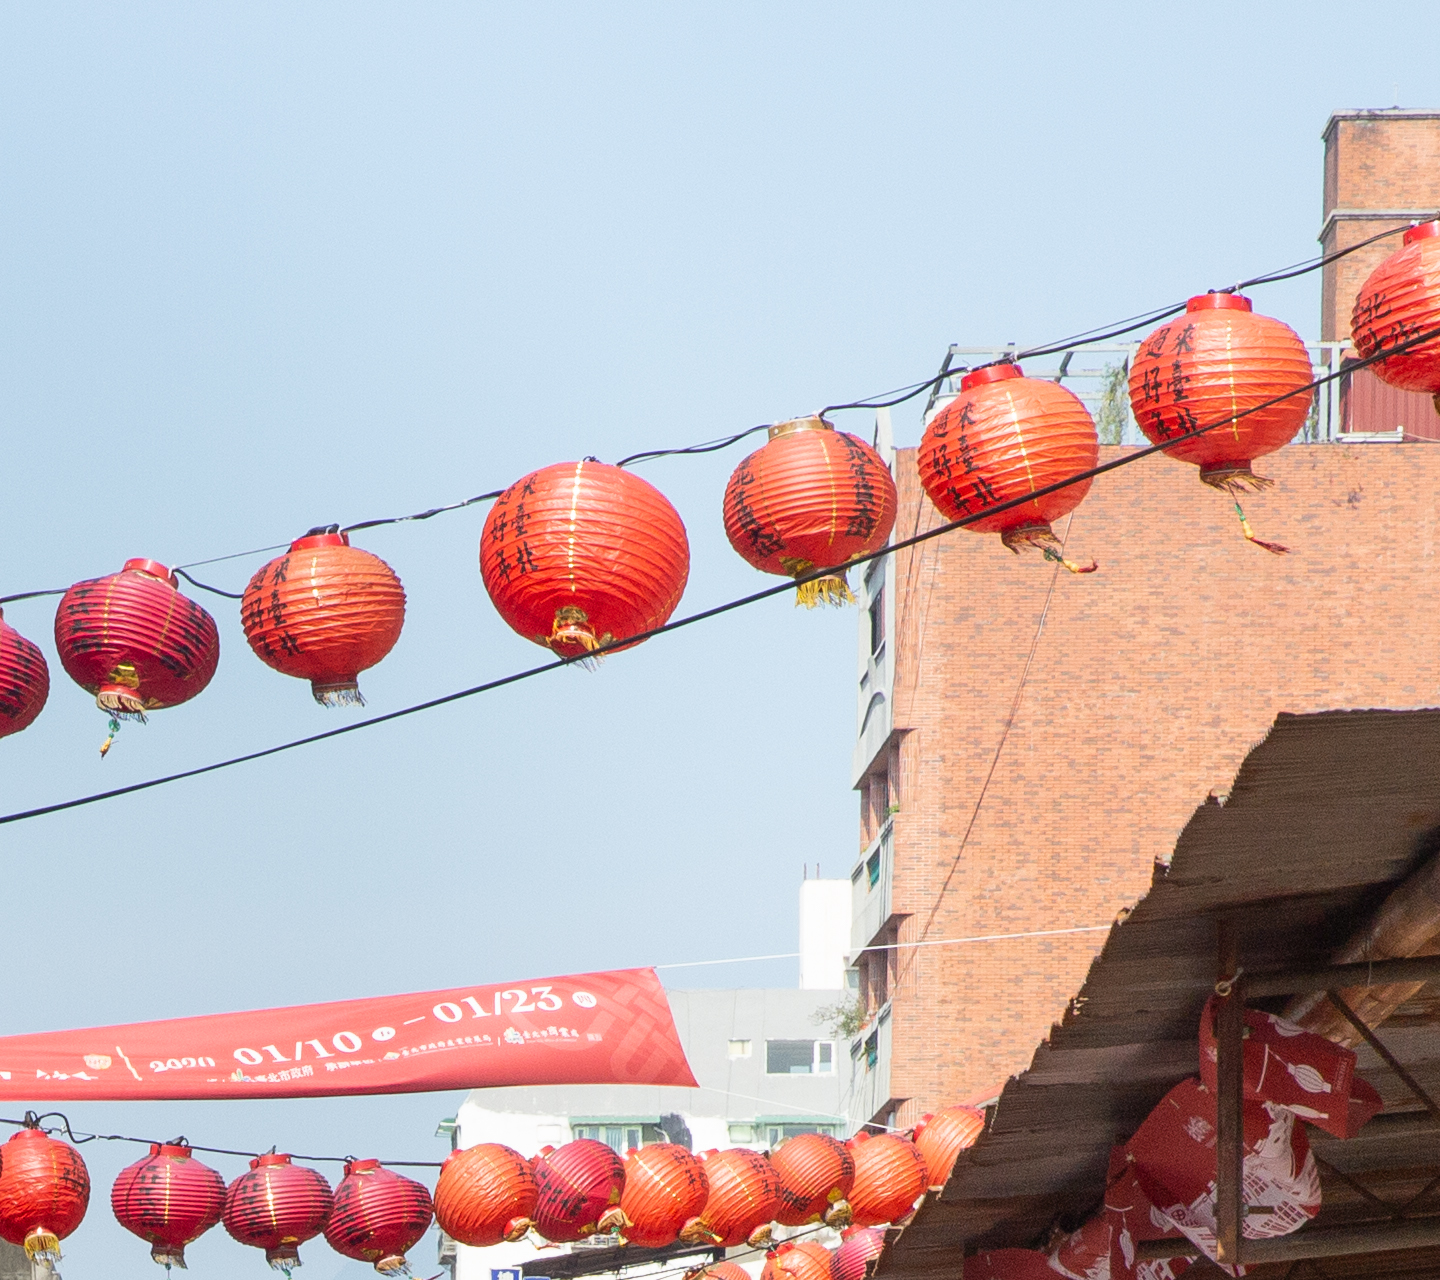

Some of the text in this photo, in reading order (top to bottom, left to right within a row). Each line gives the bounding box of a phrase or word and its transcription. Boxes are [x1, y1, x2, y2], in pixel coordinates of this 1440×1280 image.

[1167, 323, 1202, 436] 來臺北
[956, 400, 1003, 507] 來臺北
[233, 1030, 362, 1067] 01/10
[432, 985, 563, 1024] 01/23
